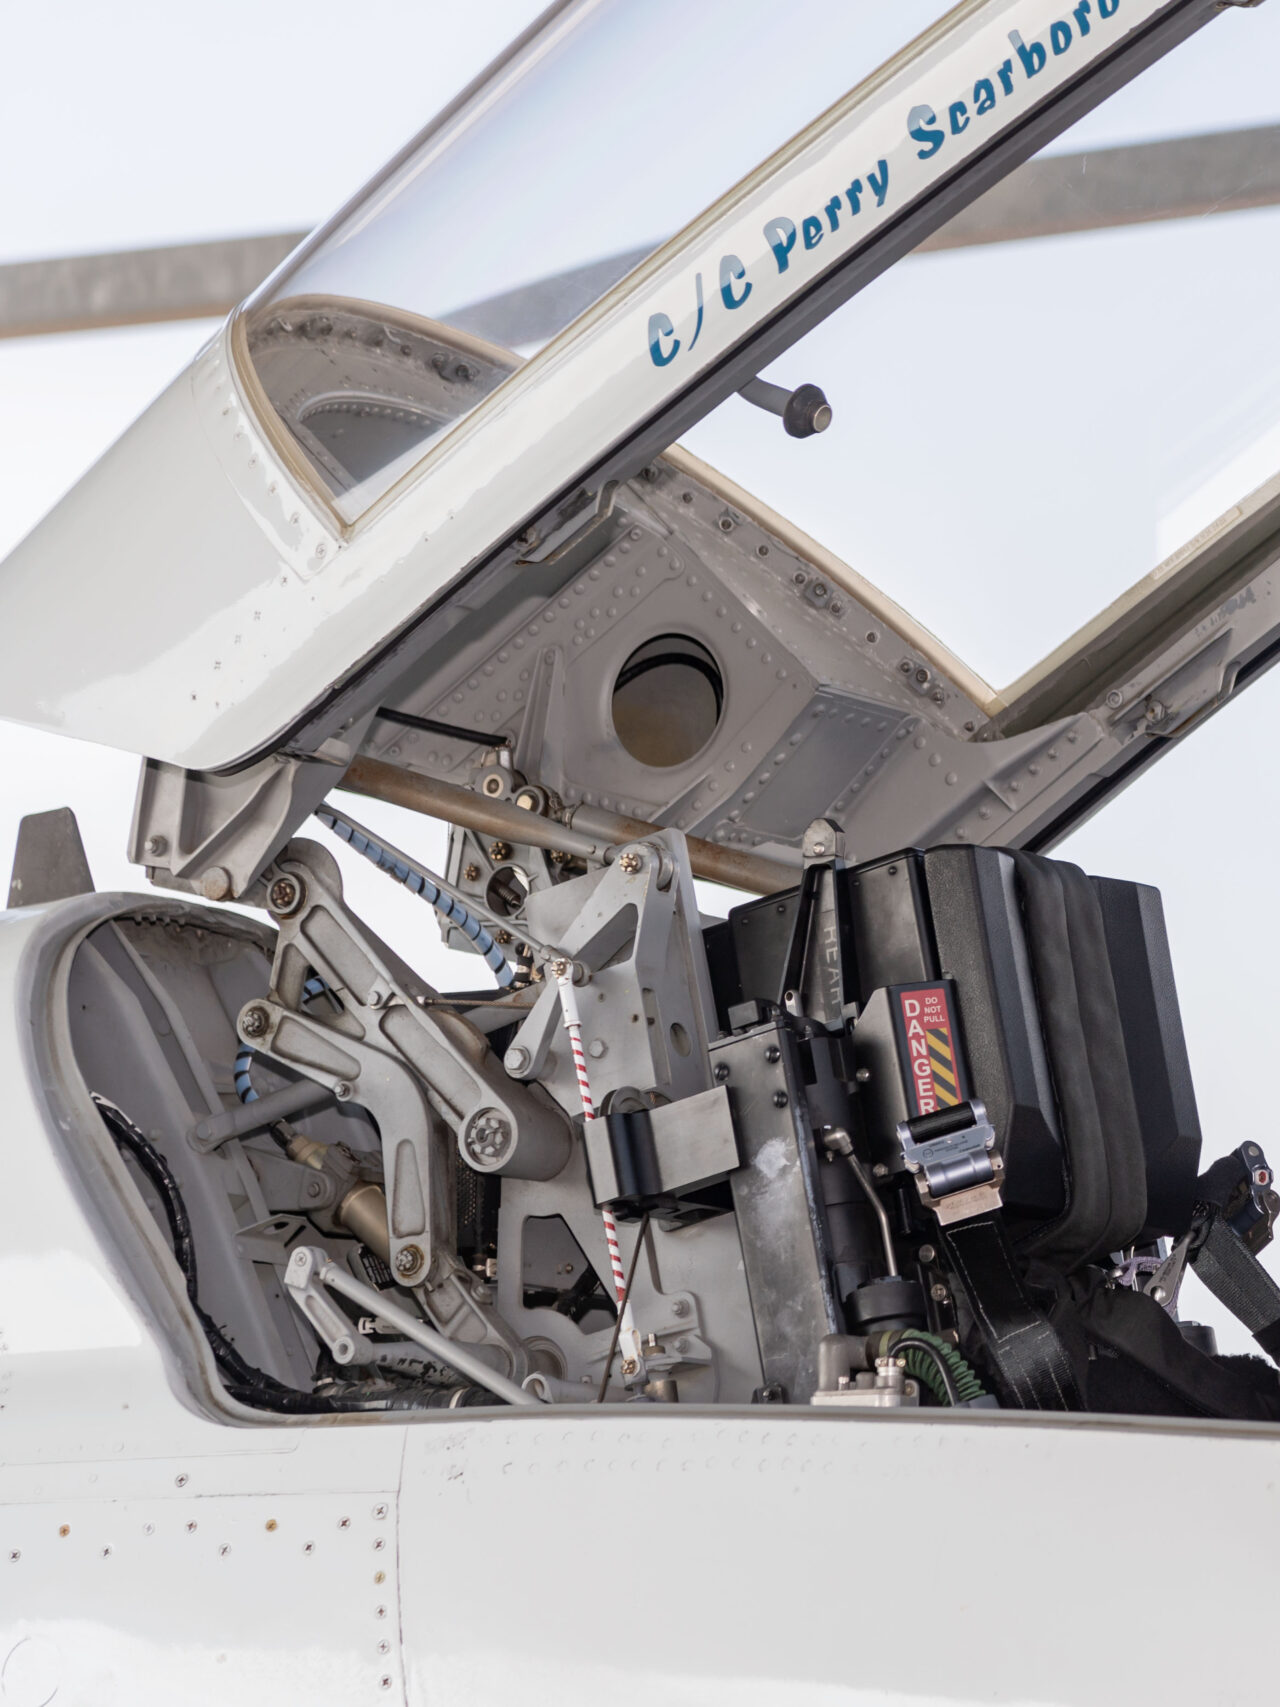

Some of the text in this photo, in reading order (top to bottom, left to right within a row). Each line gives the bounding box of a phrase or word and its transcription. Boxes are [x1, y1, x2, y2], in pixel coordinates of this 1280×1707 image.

[648, 255, 752, 367] C/C
[763, 160, 889, 275] Perry
[925, 997, 938, 1005] DO
[924, 1006, 942, 1014] NOT
[923, 1015, 945, 1023] PULL
[904, 999, 935, 1115] DANGER
